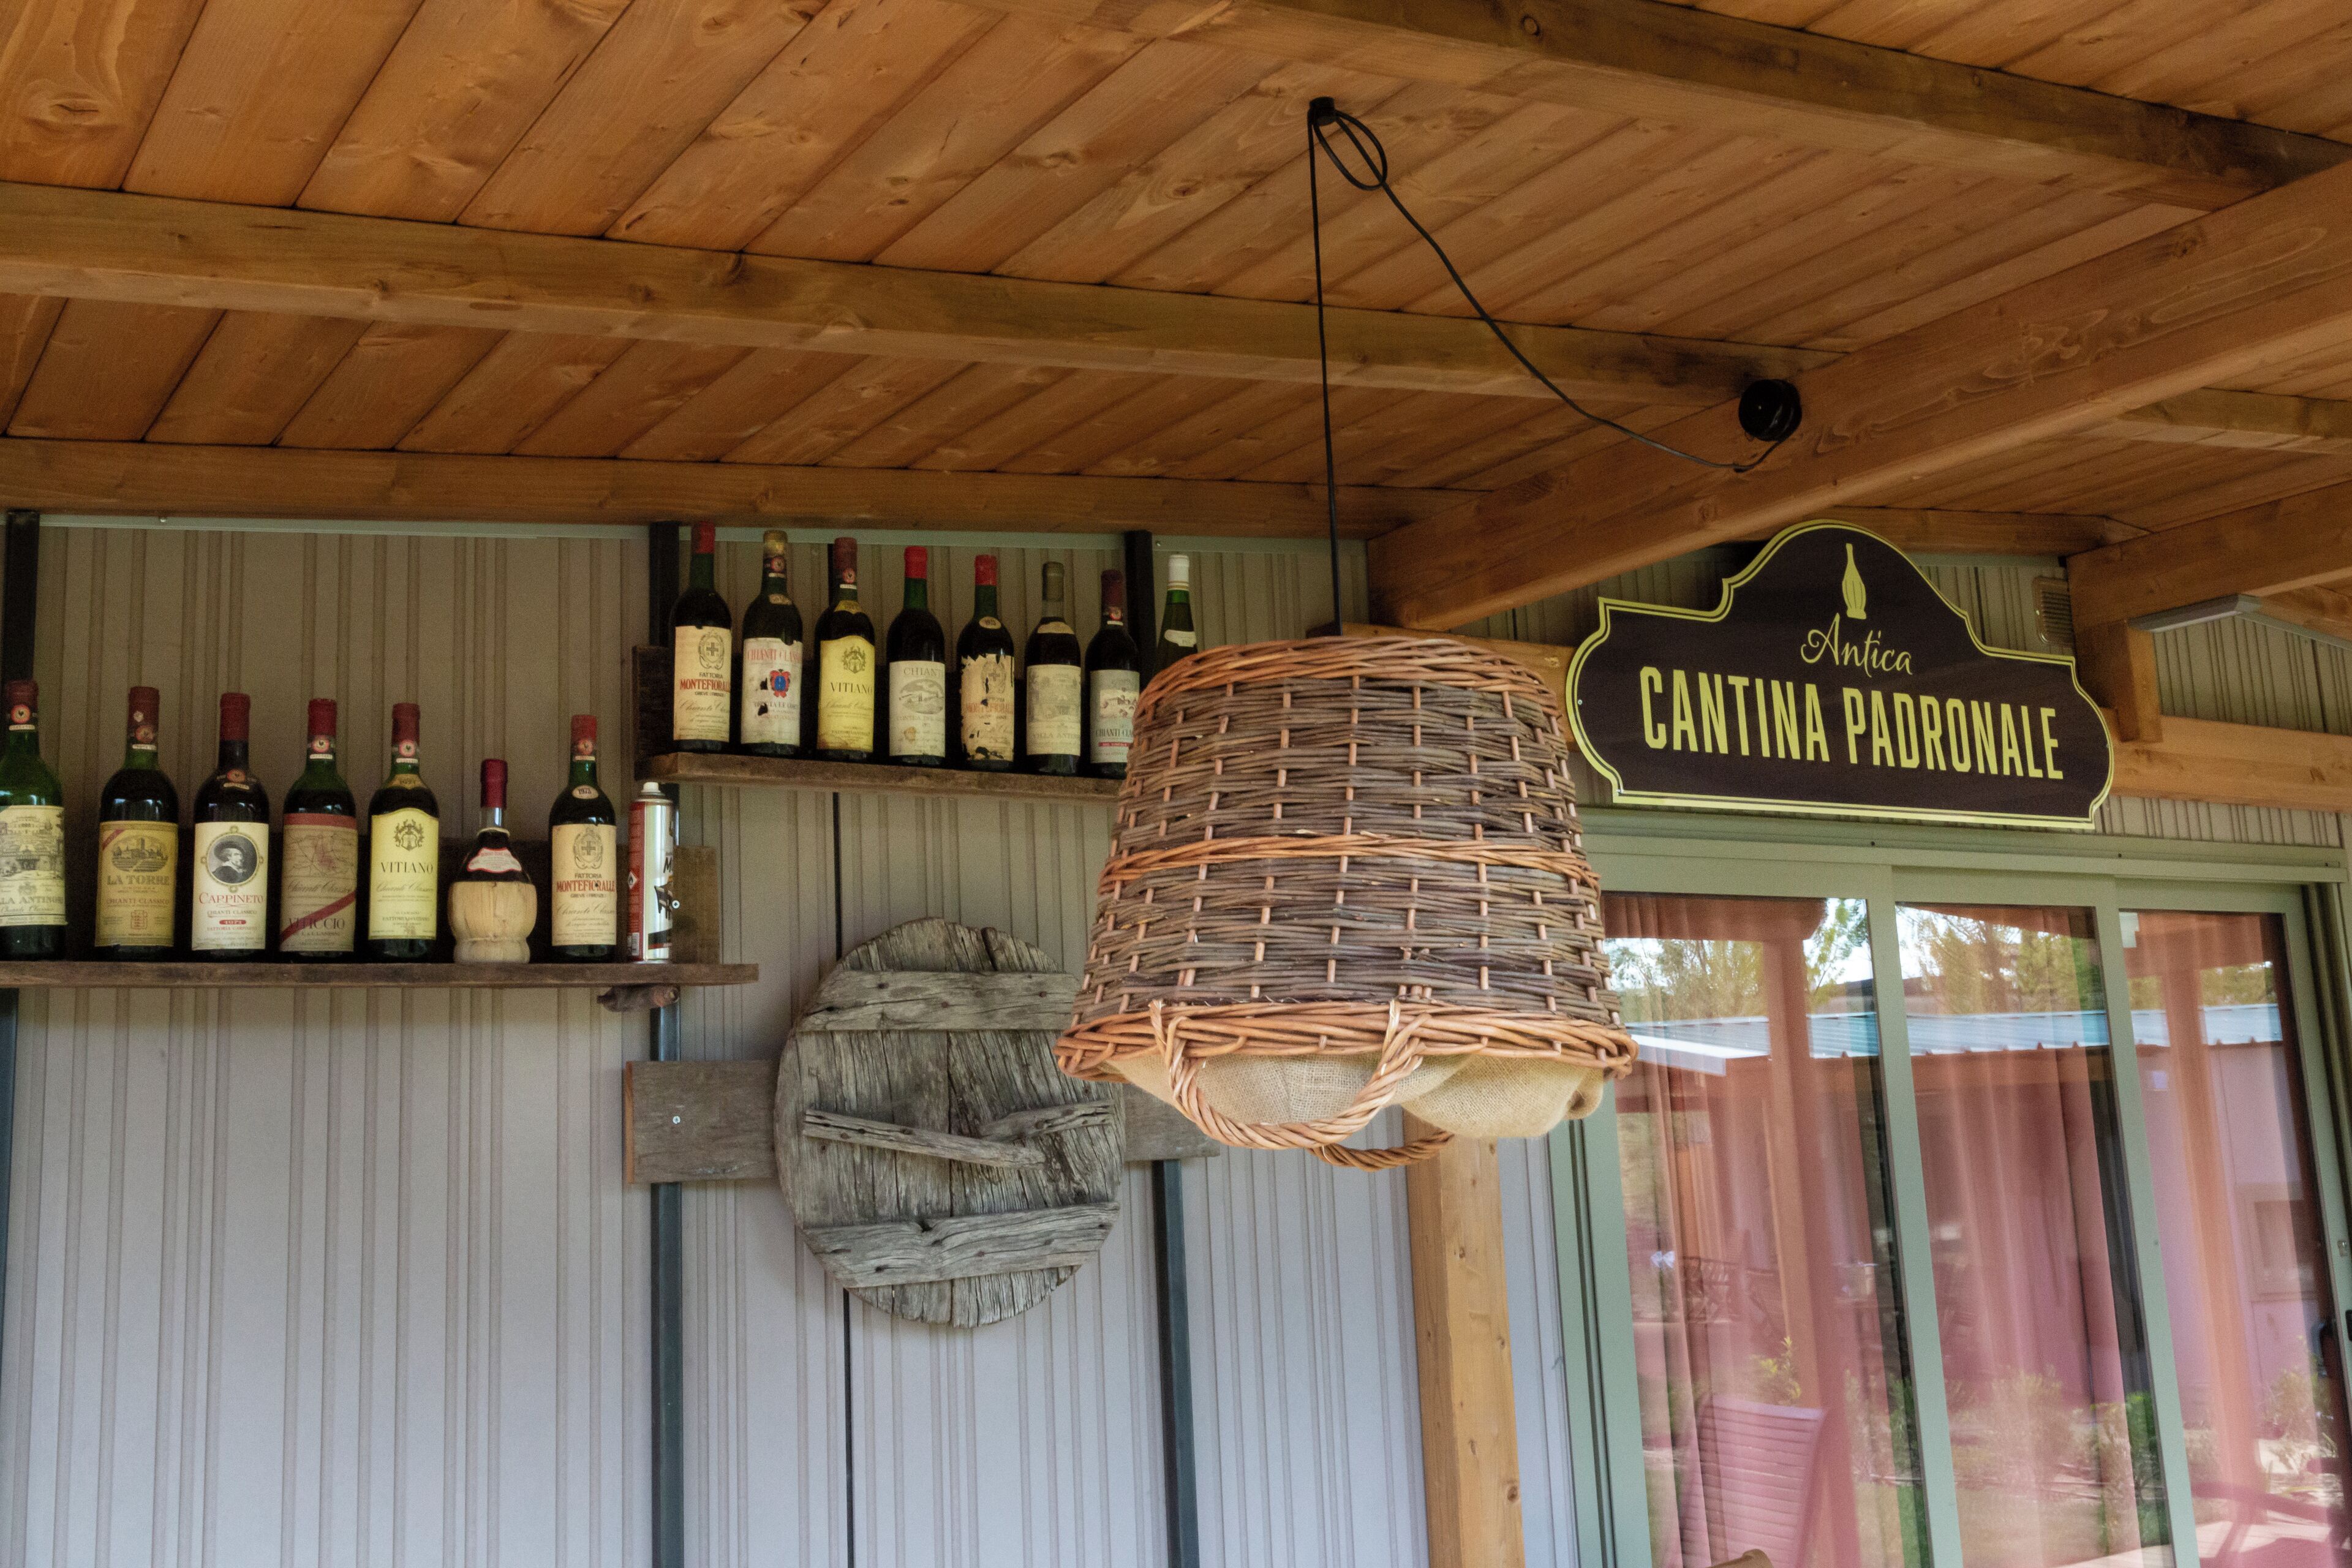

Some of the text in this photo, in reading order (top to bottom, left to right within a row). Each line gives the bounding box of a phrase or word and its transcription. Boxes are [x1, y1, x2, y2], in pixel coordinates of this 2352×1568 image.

[1800, 612, 1913, 677] Antica
[831, 682, 873, 695] VITIANO
[1640, 666, 2064, 780] CANTINA PADRONALE
[381, 861, 433, 874] VITIANO
[107, 875, 170, 886] LA TORRE
[556, 880, 616, 892] MONTEFIORALLE
